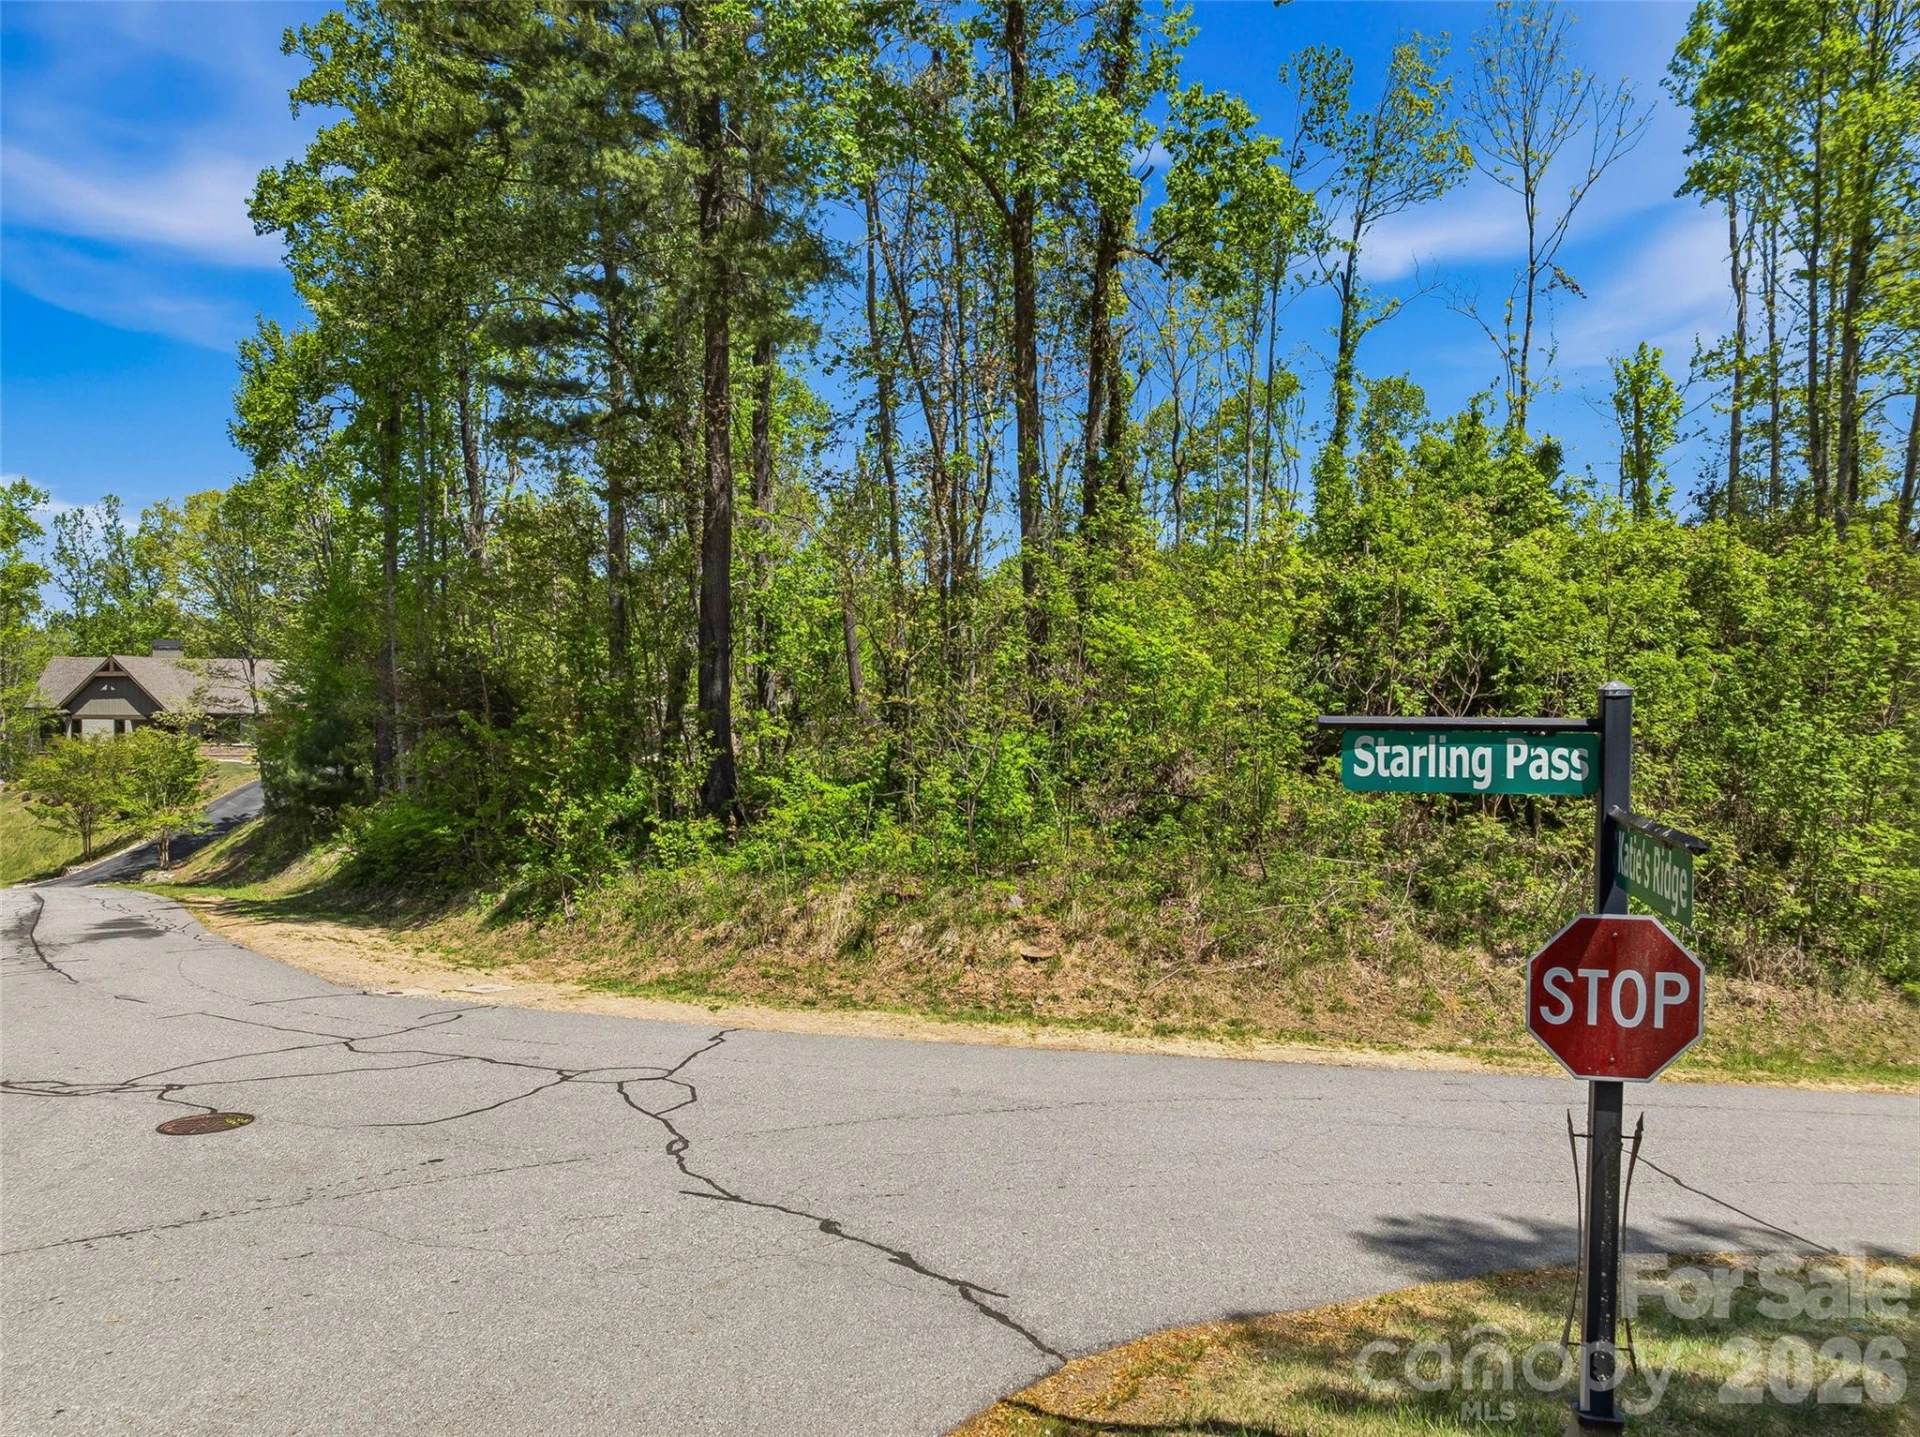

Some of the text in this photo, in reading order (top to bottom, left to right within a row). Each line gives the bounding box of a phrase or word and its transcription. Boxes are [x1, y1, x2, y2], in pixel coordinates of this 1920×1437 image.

[1353, 735, 1589, 790] Starling Pass
[1617, 831, 1688, 916] Katie's Ridge
[1539, 966, 1690, 1029] STOP
